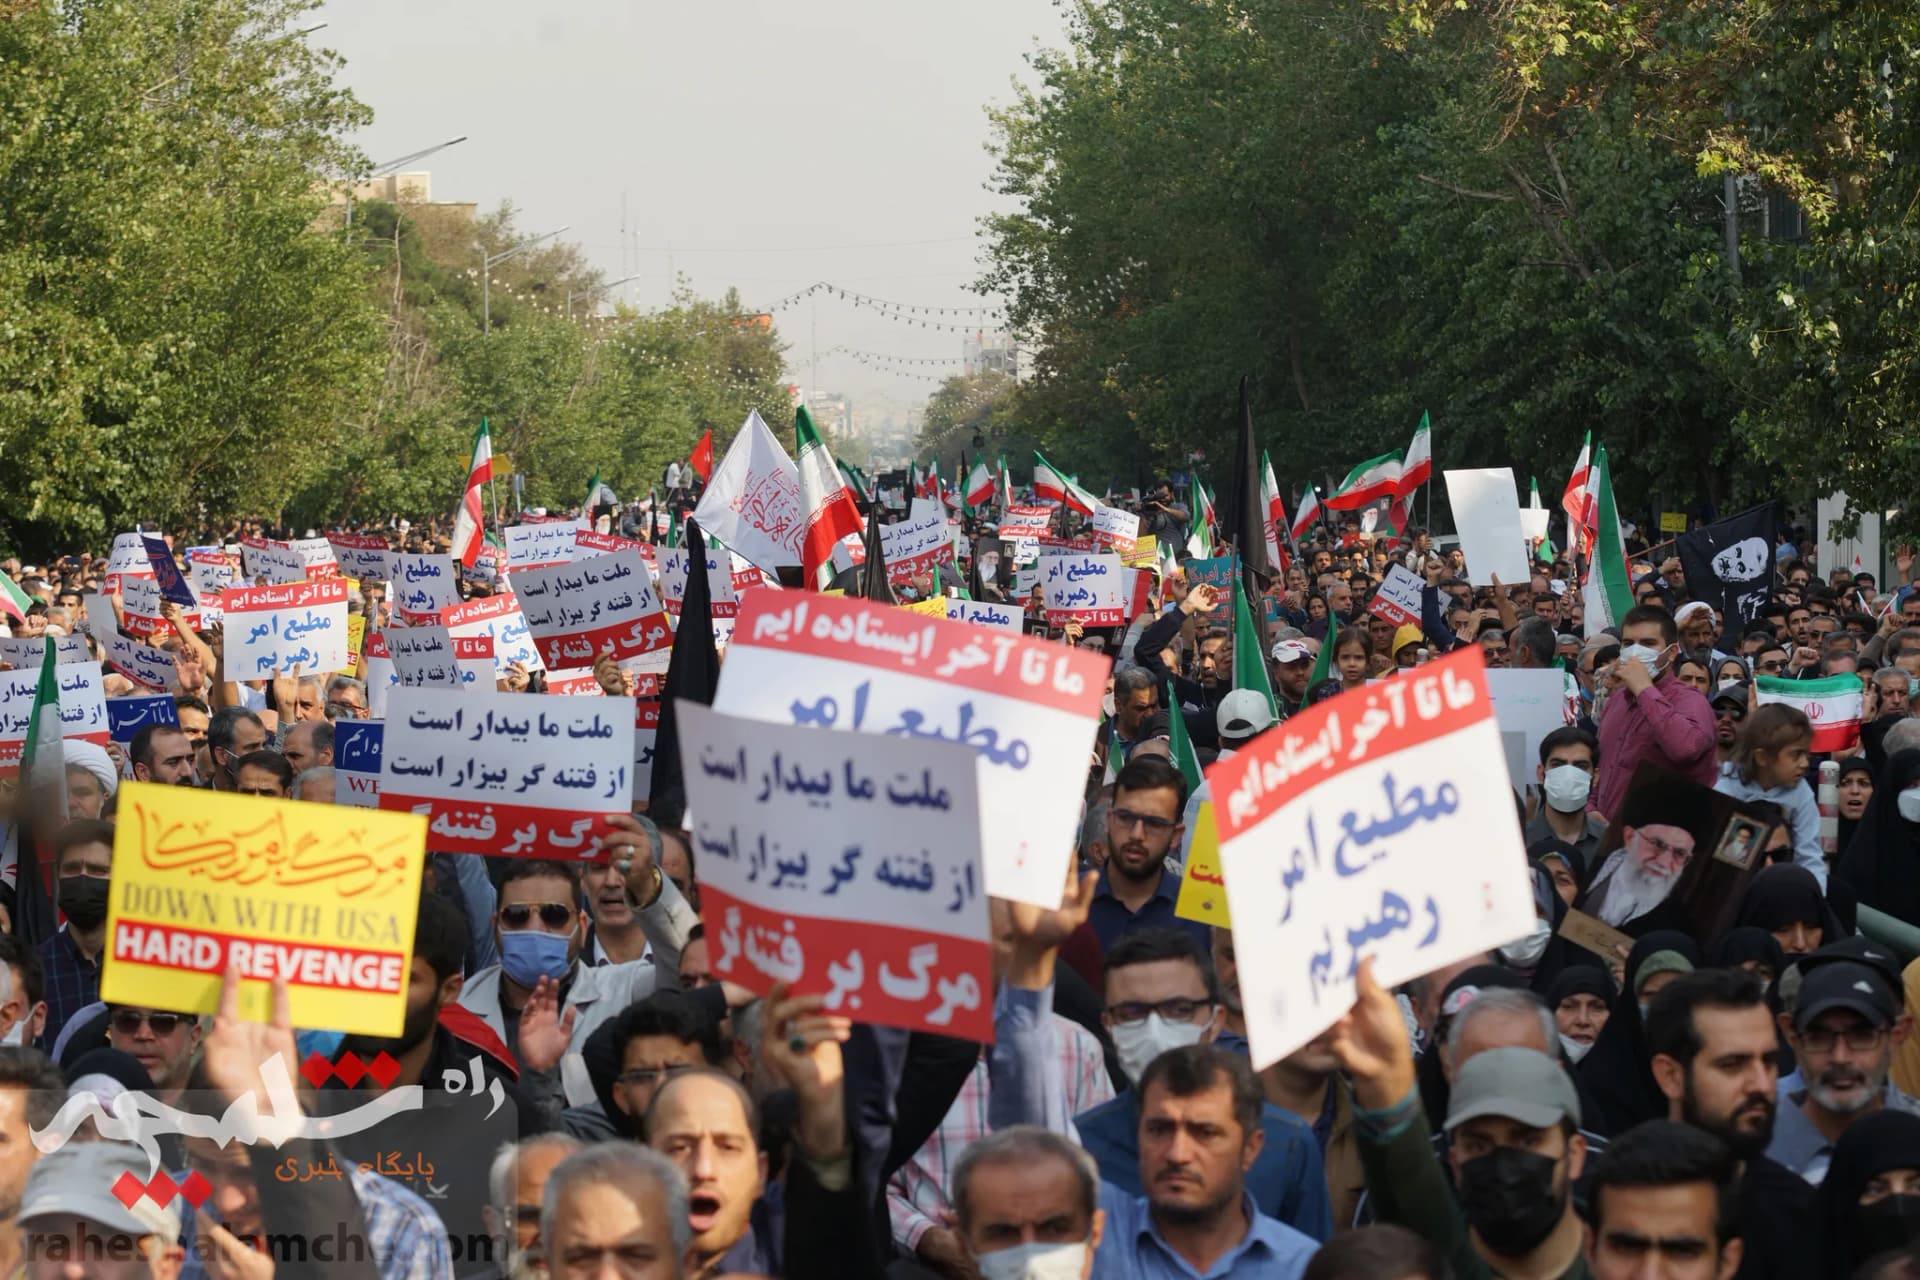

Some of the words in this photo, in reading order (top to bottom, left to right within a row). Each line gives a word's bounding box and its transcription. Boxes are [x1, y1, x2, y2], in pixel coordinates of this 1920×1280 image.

[405, 558, 441, 583] مطیع
[602, 563, 631, 582] ملت
[665, 553, 680, 574] امر
[749, 571, 758, 581] ما
[1047, 560, 1064, 582] امر
[1066, 558, 1107, 582] مطیع
[322, 585, 331, 597] تا
[333, 583, 342, 597] ما
[524, 581, 549, 597] است
[555, 576, 585, 597] بیدار
[584, 571, 600, 585] ما
[742, 574, 749, 583] تا
[231, 592, 249, 609] ایم
[252, 588, 294, 605] ایستاده
[296, 584, 319, 605] آخر
[607, 592, 633, 612] فتنه
[640, 588, 652, 609] از
[1054, 587, 1097, 607] رهبریم
[529, 610, 553, 626] است
[559, 608, 585, 627] بیزار
[717, 605, 724, 615] تا
[724, 605, 733, 614] ما
[753, 602, 808, 641] ایم
[969, 606, 1010, 625] مطیع
[1100, 612, 1107, 622] تا
[1109, 612, 1119, 622] ما
[245, 613, 279, 645] امر
[283, 610, 332, 641] مطیع
[620, 622, 665, 650] مرگ
[425, 637, 443, 651] ملت
[463, 640, 473, 652] تا
[475, 640, 487, 652] ما
[811, 614, 935, 664] ایستاده
[135, 649, 173, 667] مطیع
[256, 646, 319, 673] رهبریم
[937, 636, 1017, 676] آخر
[1019, 647, 1046, 686] تا
[61, 675, 89, 691] ملت
[1054, 656, 1085, 694] ما
[1412, 677, 1441, 720] تا
[1447, 669, 1476, 711] ما
[90, 704, 101, 724] از
[167, 701, 175, 723] ما
[409, 708, 462, 732] است
[540, 712, 559, 736] ما
[1348, 681, 1408, 758] آخر
[469, 710, 530, 742] بیدار
[567, 713, 613, 739] ملت
[701, 747, 747, 784] است
[1263, 712, 1343, 793] ایستاده
[390, 756, 444, 779] است
[451, 758, 507, 790] بیزار
[514, 763, 545, 792] گر
[552, 763, 597, 789] فتنه
[843, 759, 875, 801] ما
[603, 766, 624, 798] از
[757, 754, 832, 808] بیدار
[886, 768, 952, 811] ملت
[1227, 758, 1264, 828] ایم
[1333, 770, 1460, 878] مطیع
[502, 822, 538, 853] بر
[548, 818, 603, 858] رگ
[699, 824, 738, 861] است
[746, 834, 808, 889] بیزار
[823, 844, 862, 894] گر
[875, 851, 935, 893] فتنه
[1278, 805, 1321, 926] امر
[947, 861, 975, 912] از
[121, 881, 220, 924] DOWN
[233, 897, 321, 937] WITH
[336, 908, 401, 946] USA
[116, 924, 220, 970] HARD
[228, 940, 404, 991] REVENGE
[1308, 890, 1442, 1006] رهبریم
[824, 949, 865, 1010] بر
[879, 943, 982, 1025] مرگ
